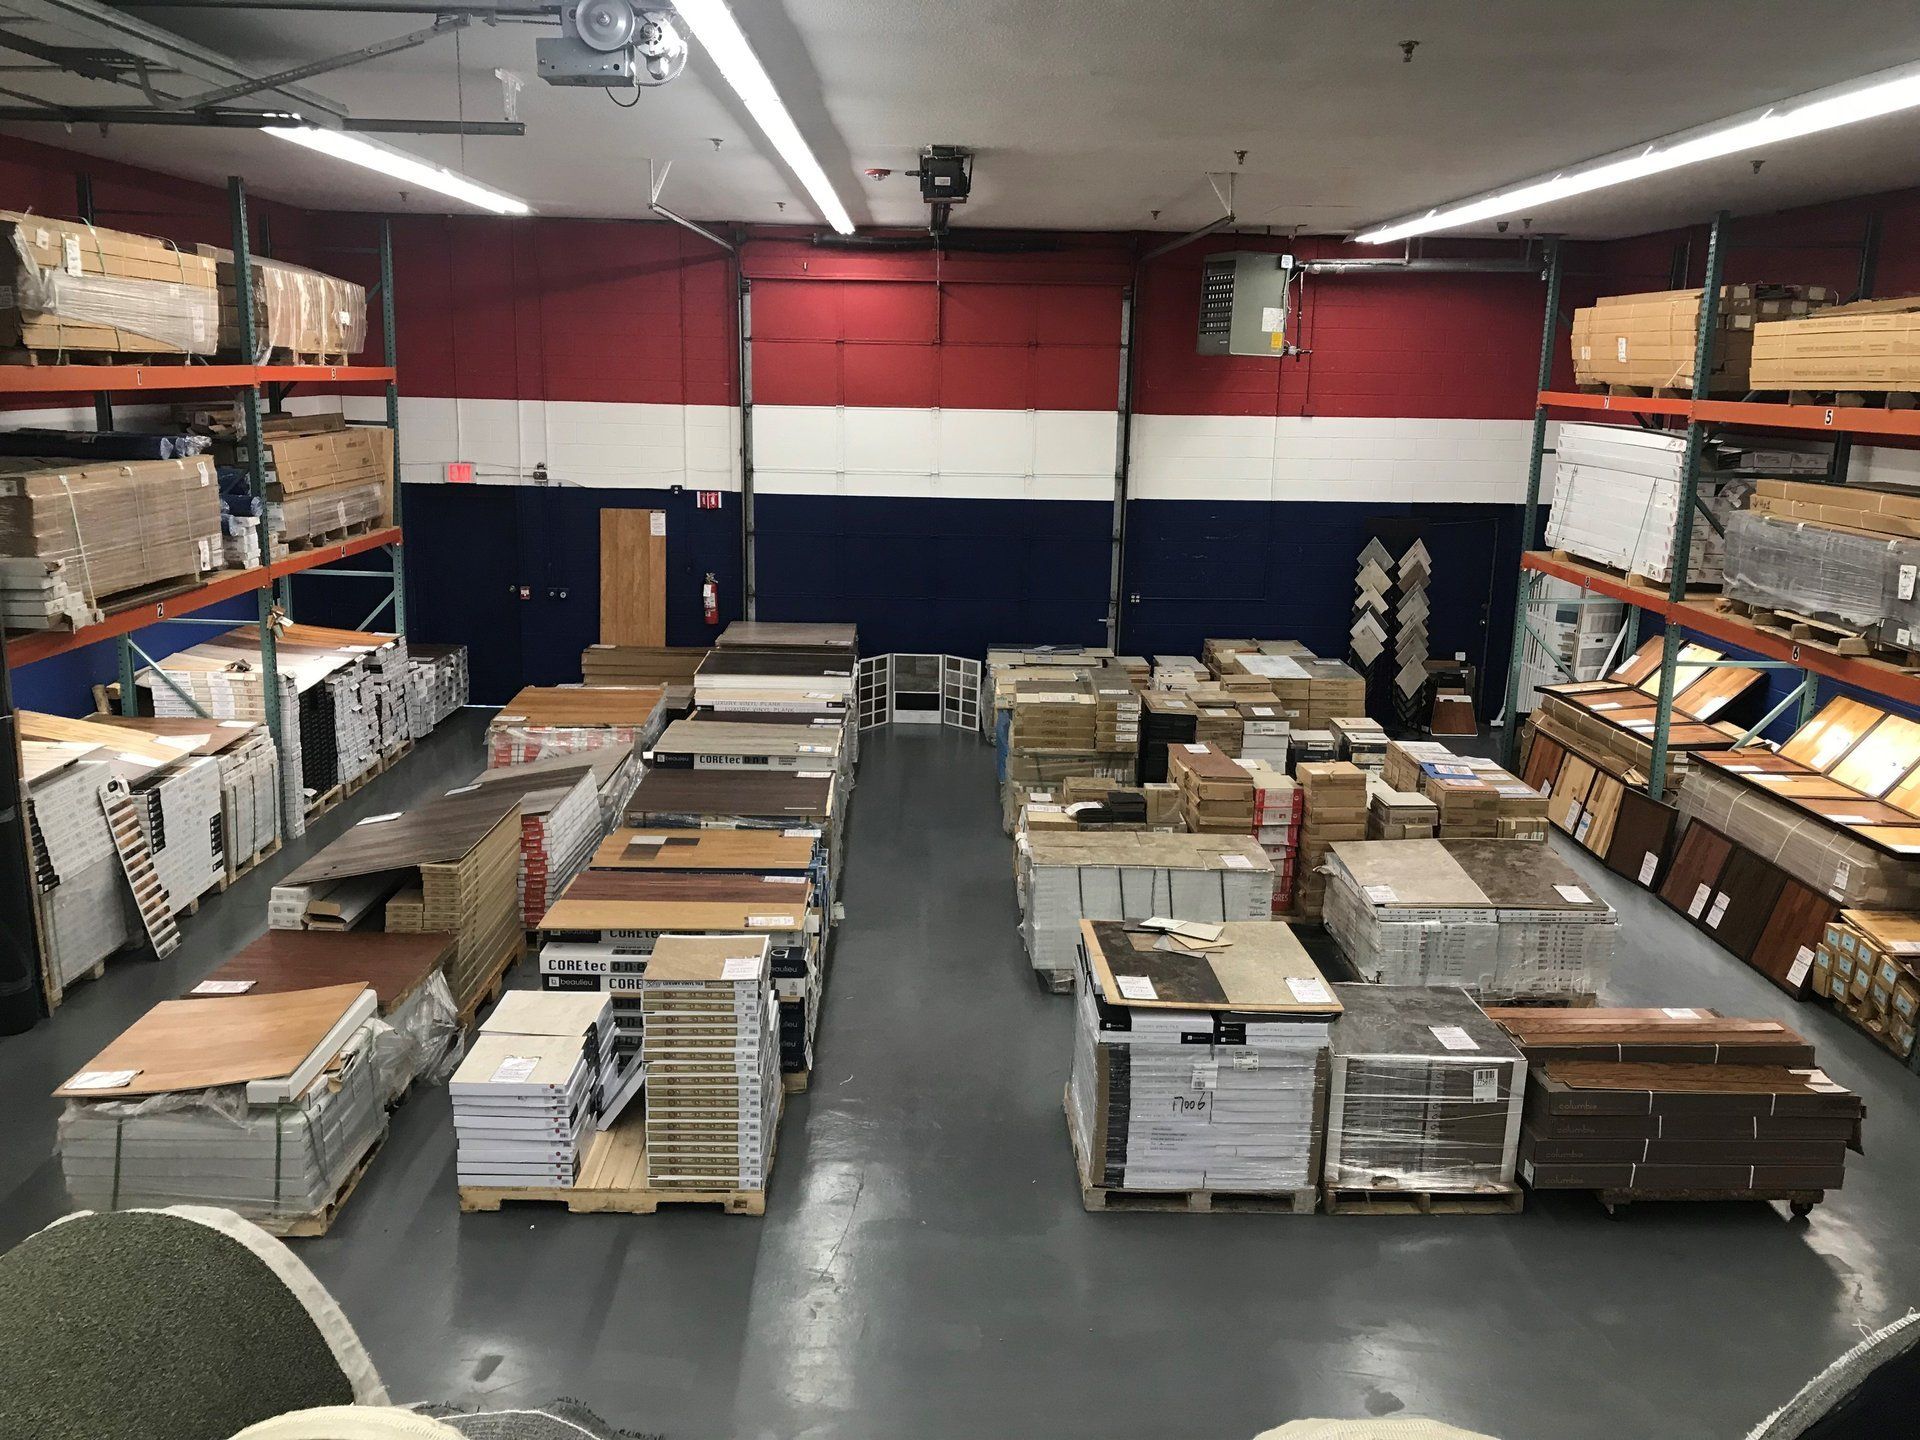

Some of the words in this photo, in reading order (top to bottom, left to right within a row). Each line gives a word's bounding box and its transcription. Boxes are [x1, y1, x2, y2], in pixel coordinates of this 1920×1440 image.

[1825, 410, 1832, 424] 5
[699, 755, 741, 764] COREtec
[548, 959, 607, 972] COREtec
[560, 978, 593, 986] beaulieu
